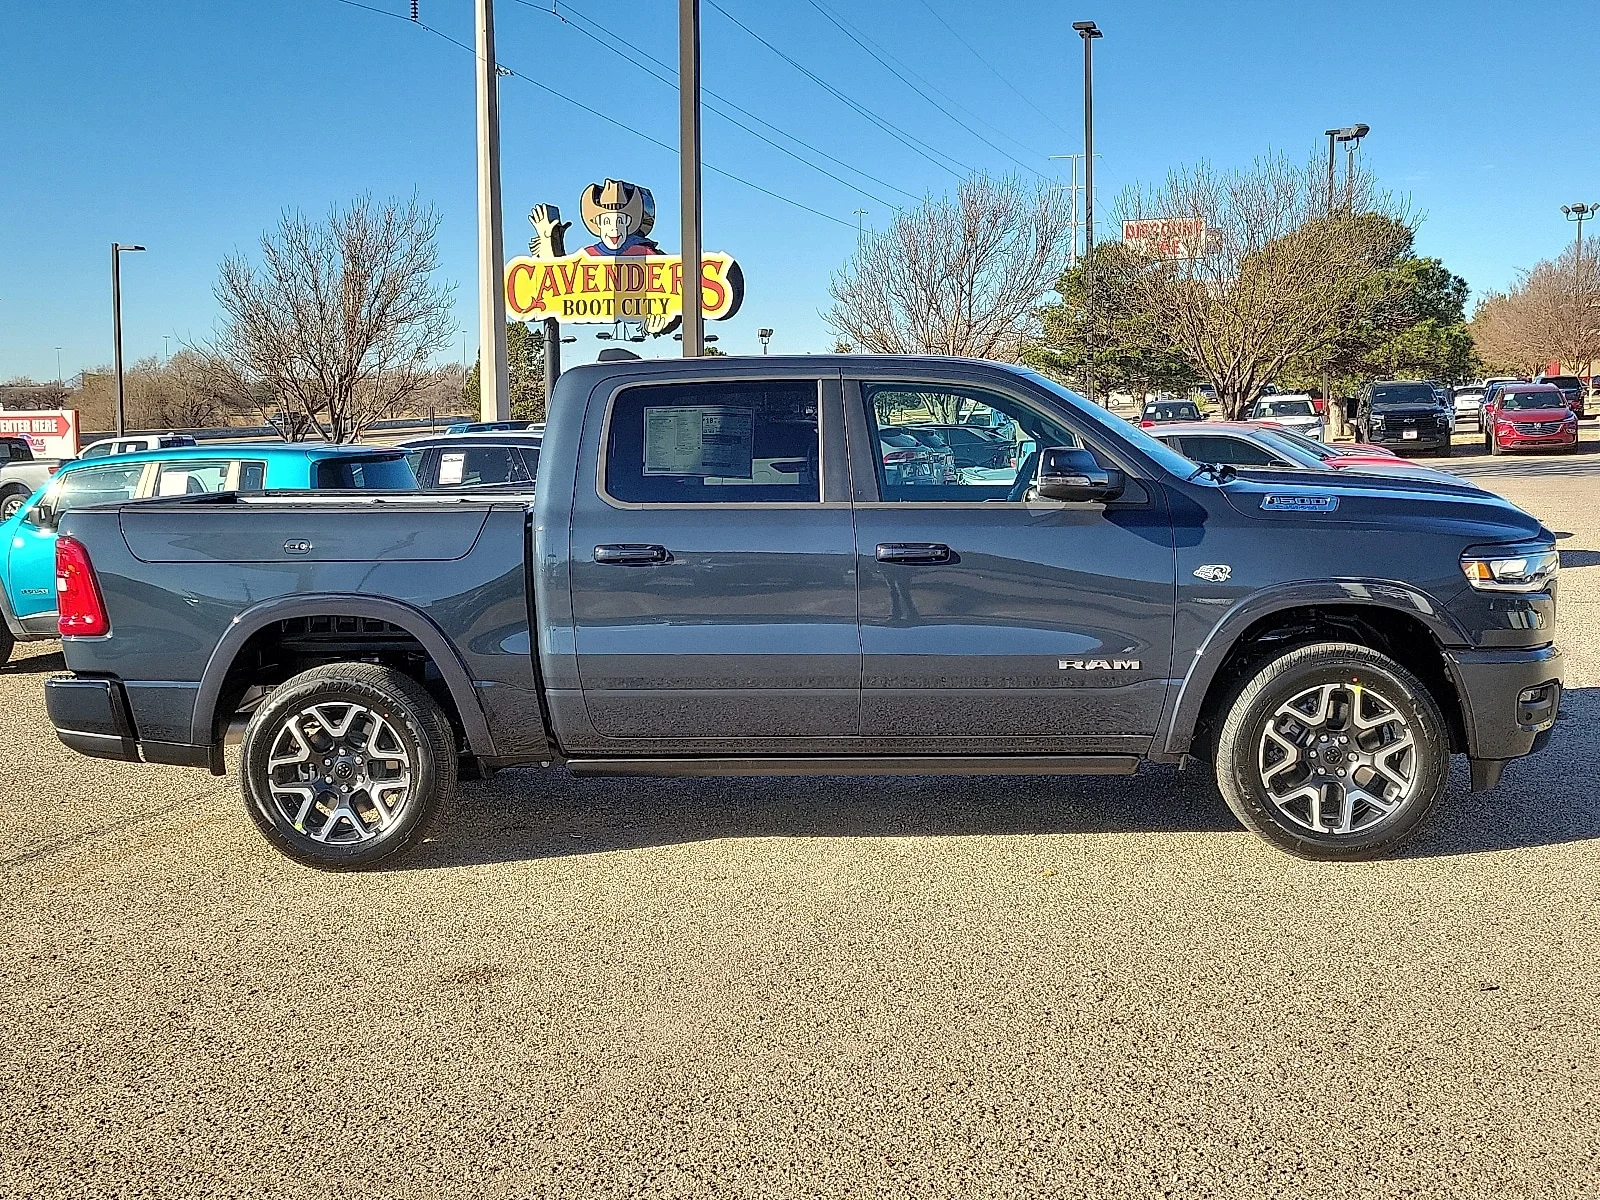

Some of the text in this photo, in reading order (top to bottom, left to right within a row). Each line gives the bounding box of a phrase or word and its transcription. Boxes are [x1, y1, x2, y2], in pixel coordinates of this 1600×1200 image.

[563, 297, 670, 316] BOOT CITY
[0, 419, 58, 433] ENTER HERE
[1271, 496, 1326, 505] 1500
[1058, 659, 1140, 670] RAM
